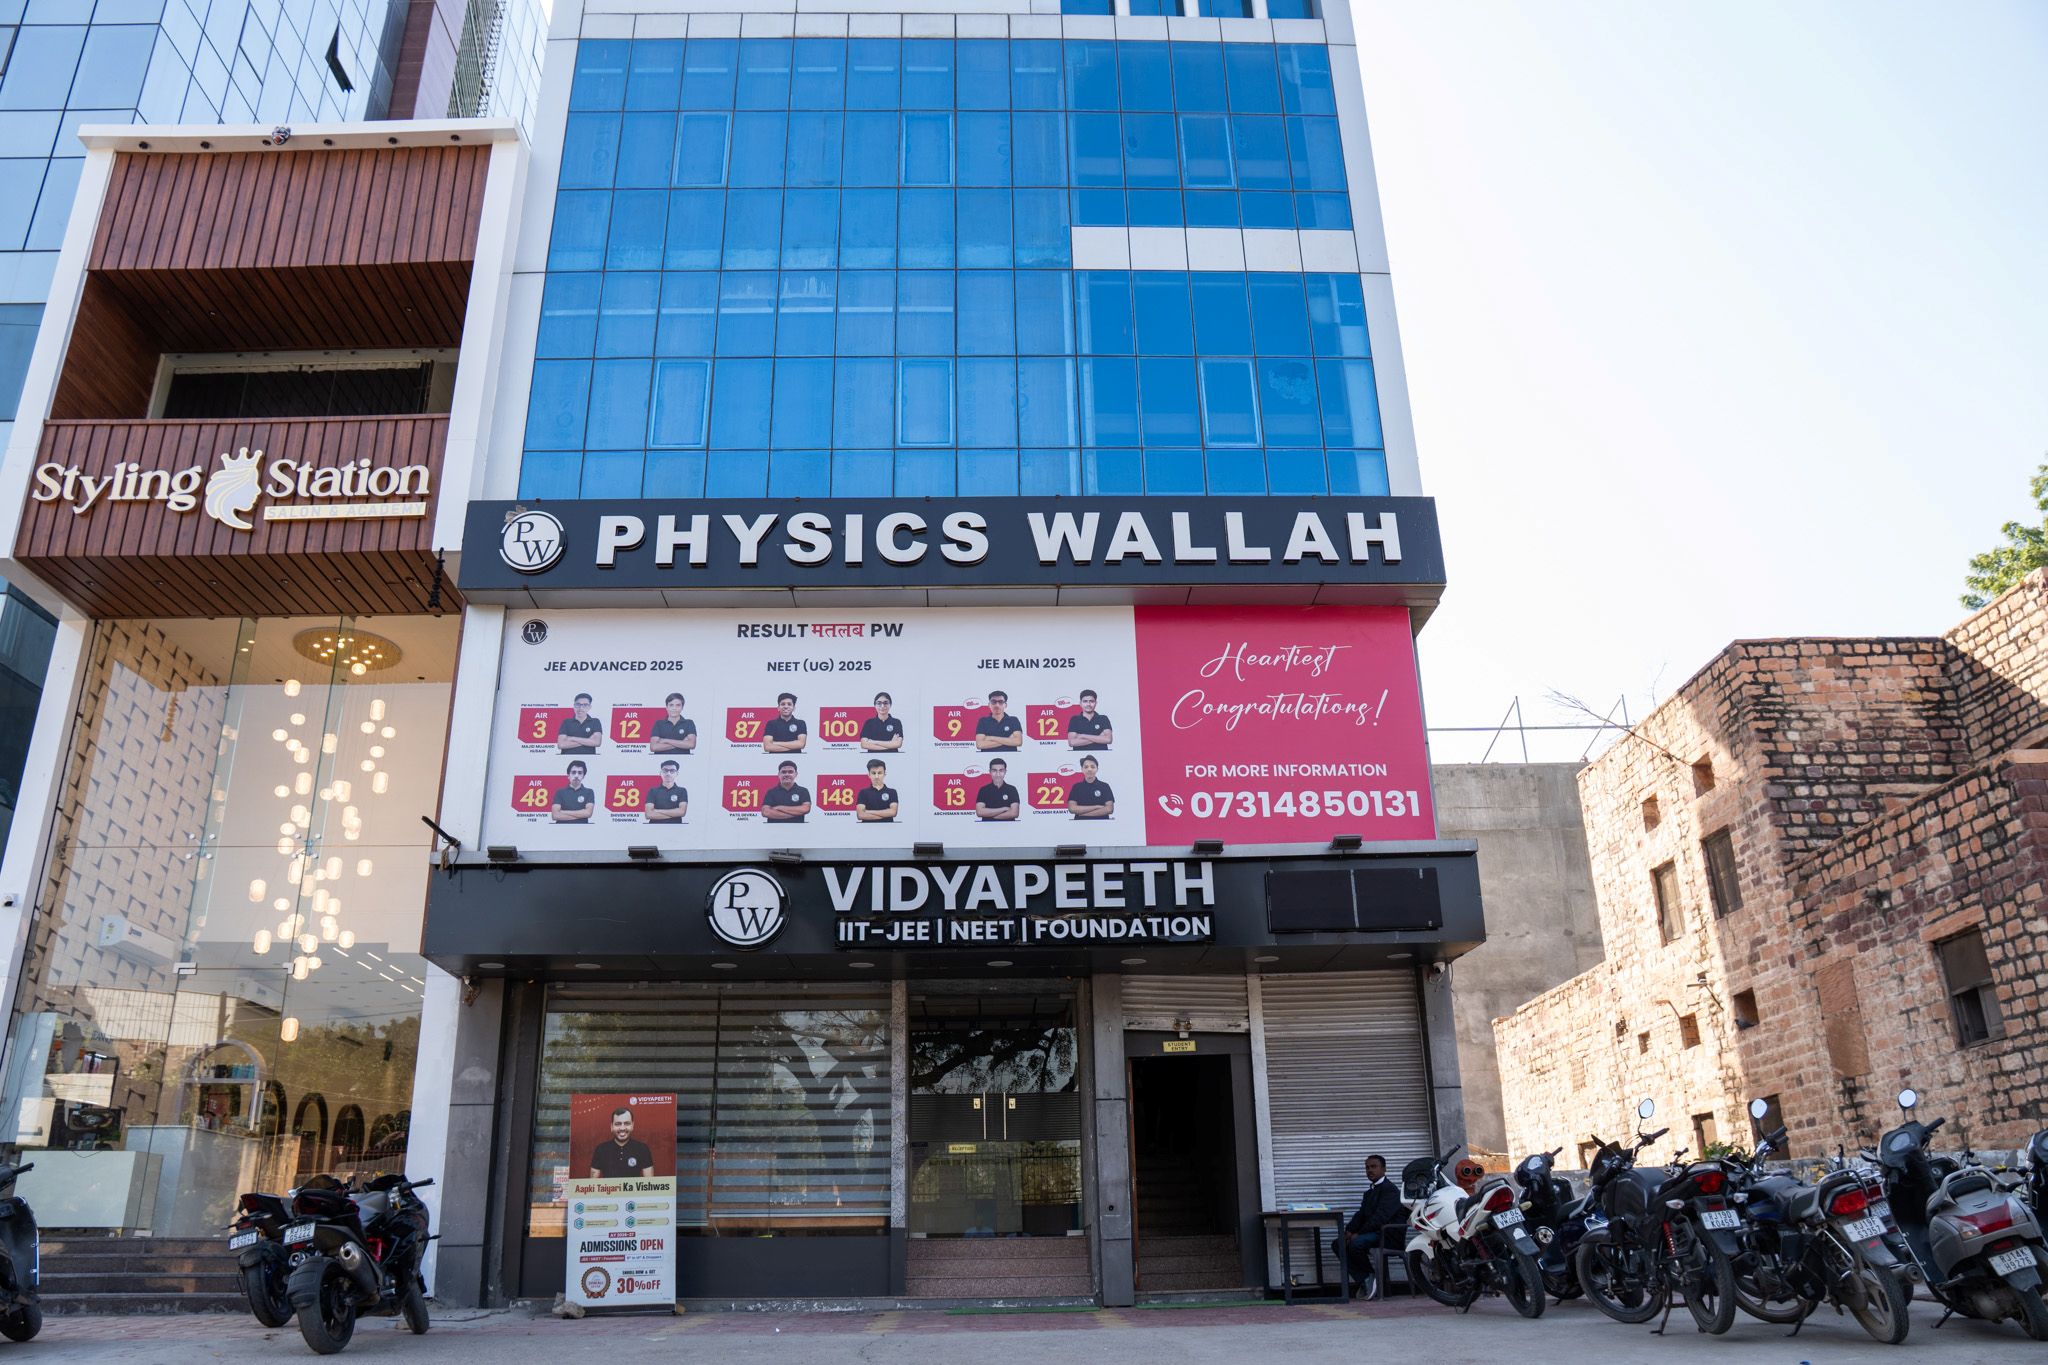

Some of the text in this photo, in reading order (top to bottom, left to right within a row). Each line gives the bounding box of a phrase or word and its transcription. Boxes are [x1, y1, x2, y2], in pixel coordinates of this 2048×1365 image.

[32, 458, 430, 516] Styling Station
[266, 503, 423, 519] SALON & ACADEMY
[595, 511, 1402, 568] PHYSICS WALLAH
[736, 622, 904, 639] RESULT मतलब PW
[544, 660, 684, 672] JEE ADVANCED 2025
[767, 658, 872, 673] NEET (UG) 2025
[977, 657, 1076, 669] JEE MAIN 2025
[1199, 641, 1353, 682] Heartiest
[1170, 688, 1390, 732] Congratulations!
[532, 720, 547, 739] 3
[619, 719, 641, 739] 12
[734, 720, 761, 739] 87
[822, 719, 858, 737] 100
[947, 719, 962, 737] 9
[1036, 717, 1059, 736] 12
[1185, 763, 1388, 778] FOR MORE INFORMATION
[519, 788, 548, 807] 48
[612, 788, 640, 807] 58
[730, 789, 759, 808] 131
[821, 788, 854, 806] 148
[944, 787, 966, 806] 13
[1036, 786, 1065, 805] 22
[1191, 790, 1420, 819] 07314850131
[821, 861, 1215, 913] VIDYAPEETH
[838, 918, 930, 942] IIT-JEE
[950, 918, 1015, 942] NEET
[1034, 916, 1212, 940] FOUNDATION
[575, 1181, 670, 1195] Aapki Taiyari Ka Vishwas
[580, 1238, 664, 1253] ADMISSIONS OPEN
